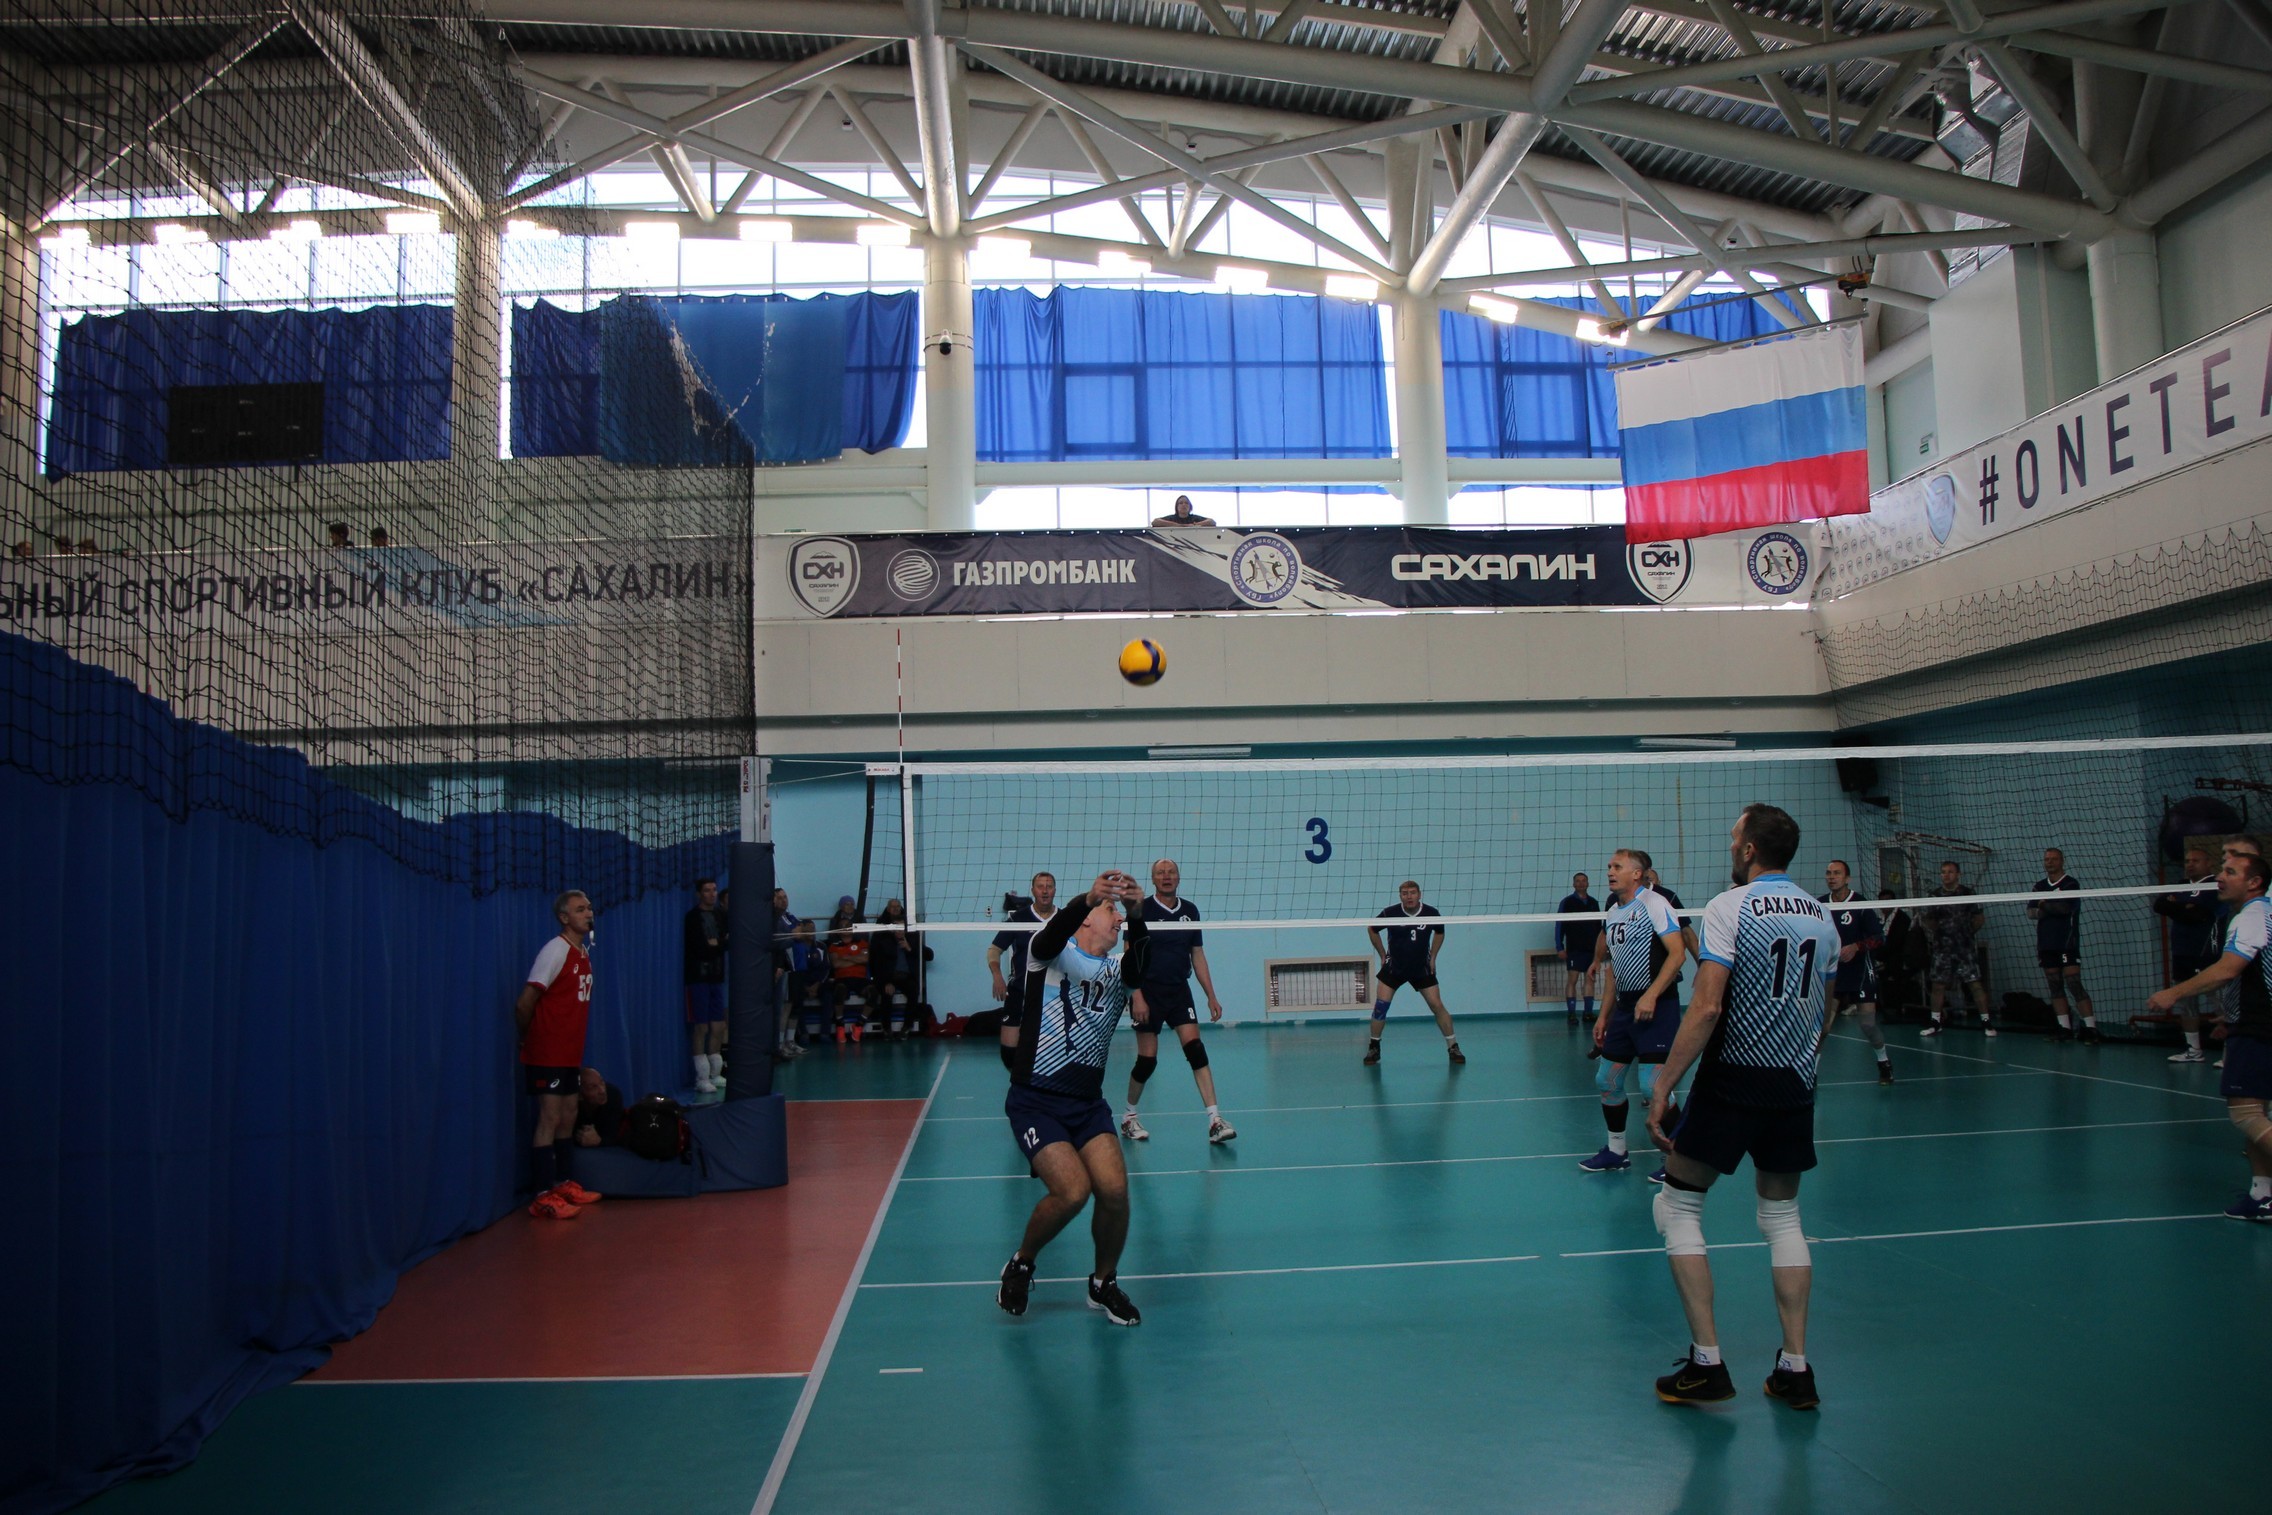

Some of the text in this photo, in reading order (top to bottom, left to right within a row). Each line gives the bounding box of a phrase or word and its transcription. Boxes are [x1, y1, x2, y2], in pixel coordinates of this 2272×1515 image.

[1979, 343, 2272, 526] #ONETE
[953, 559, 1137, 586] ГАЗПРОМБАНК
[1391, 553, 1596, 581] САХАЛИН
[119, 562, 385, 616] СПОРТИВНЫЙ
[400, 568, 502, 607] КЛУБ
[1304, 817, 1332, 864] 3
[1751, 896, 1825, 921] САХАЛИН
[1410, 929, 1417, 941] 3
[1611, 923, 1626, 946] 15
[1769, 938, 1817, 1000] 11
[1079, 978, 1107, 1014] 12
[1023, 1126, 1040, 1149] 12
